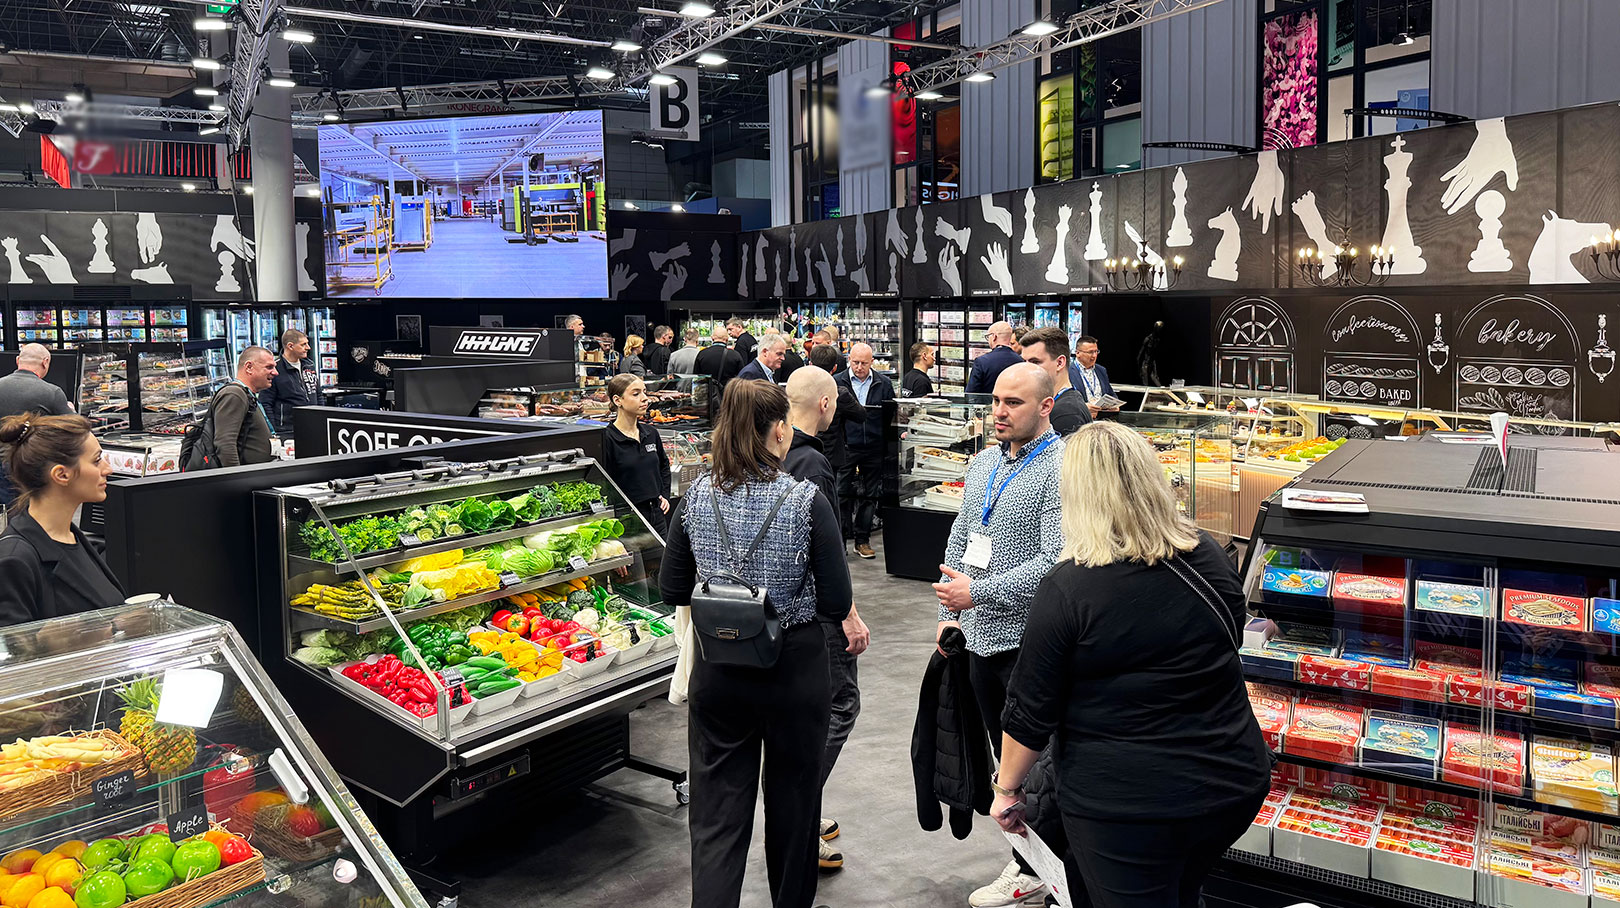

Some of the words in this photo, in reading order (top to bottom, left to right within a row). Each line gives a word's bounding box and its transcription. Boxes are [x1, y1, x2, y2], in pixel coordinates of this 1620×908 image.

[660, 75, 690, 128] B
[1379, 387, 1412, 401] BAKED
[1509, 594, 1543, 602] PREMIUM
[1545, 595, 1580, 610] SEAFOODS
[96, 775, 130, 792] Ginger
[173, 815, 203, 836] Apple
